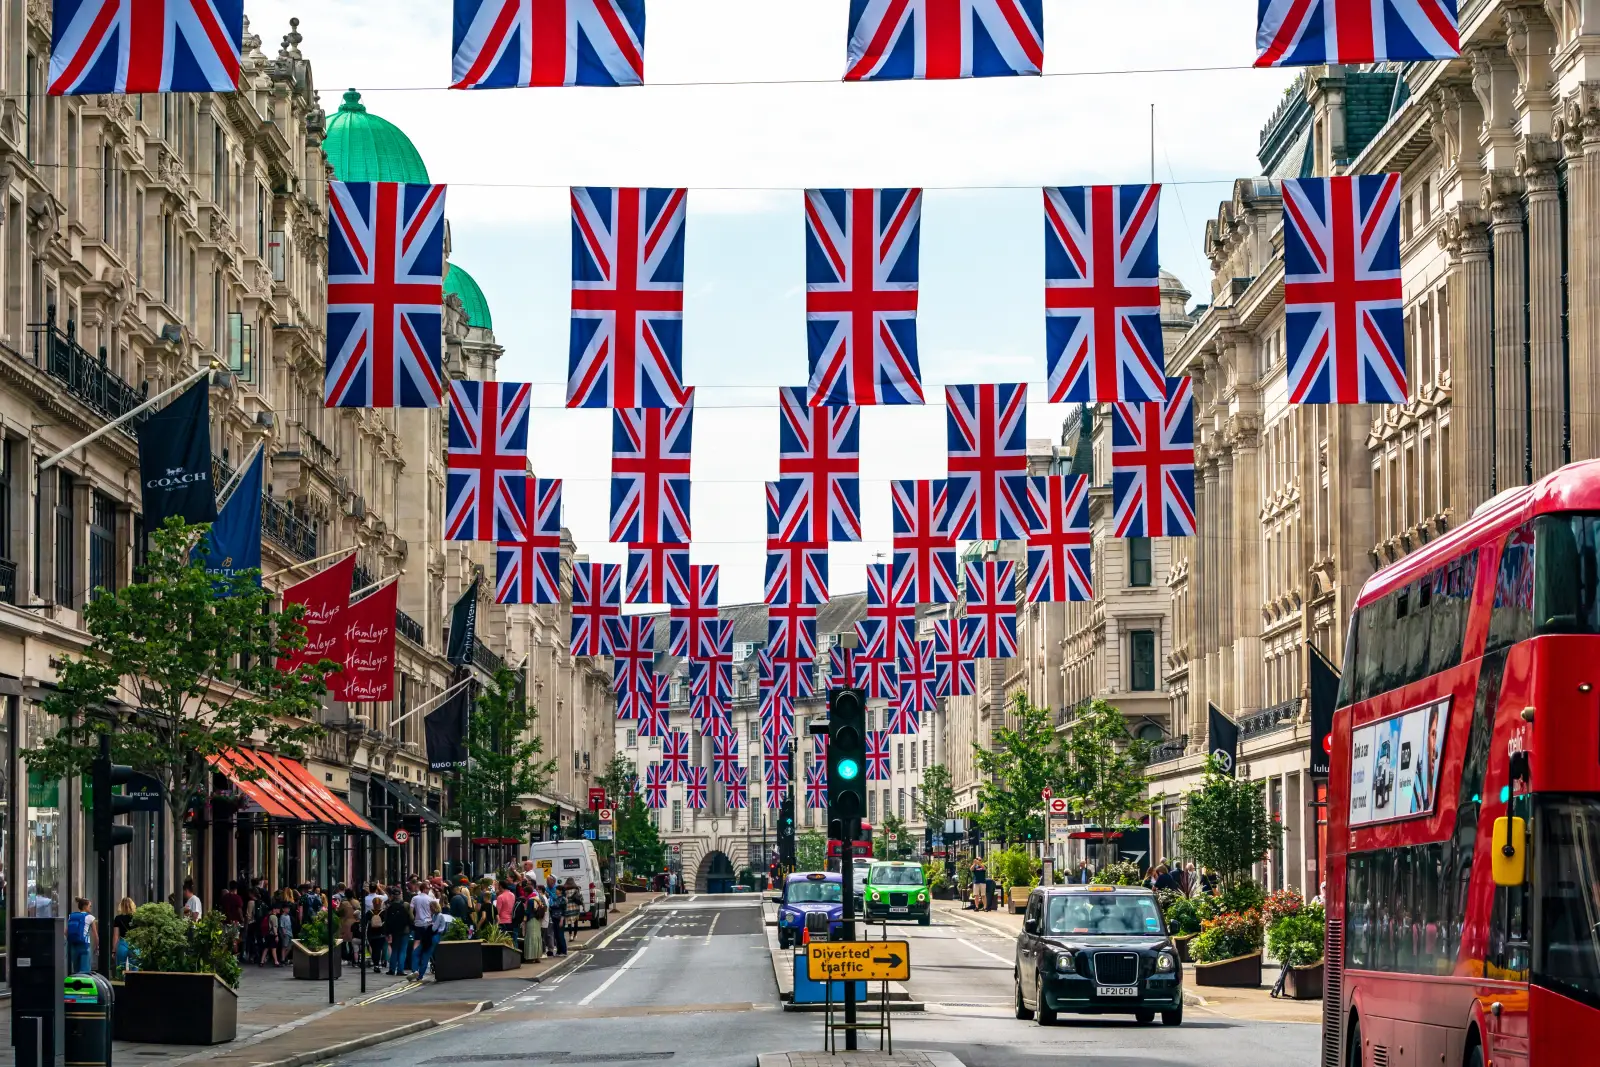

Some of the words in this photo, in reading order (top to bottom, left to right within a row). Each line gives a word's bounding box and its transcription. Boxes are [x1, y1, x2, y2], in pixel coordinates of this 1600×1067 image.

[146, 471, 207, 489] COACH
[296, 597, 340, 624] amleys
[344, 619, 389, 644] Hamleys
[462, 627, 474, 663] Calvin
[343, 647, 388, 672] Hamleys
[342, 676, 387, 699] Hamleys
[431, 761, 452, 769] HUGO
[396, 832, 407, 840] 20
[812, 948, 870, 959] Diverted
[821, 962, 864, 972] traffic
